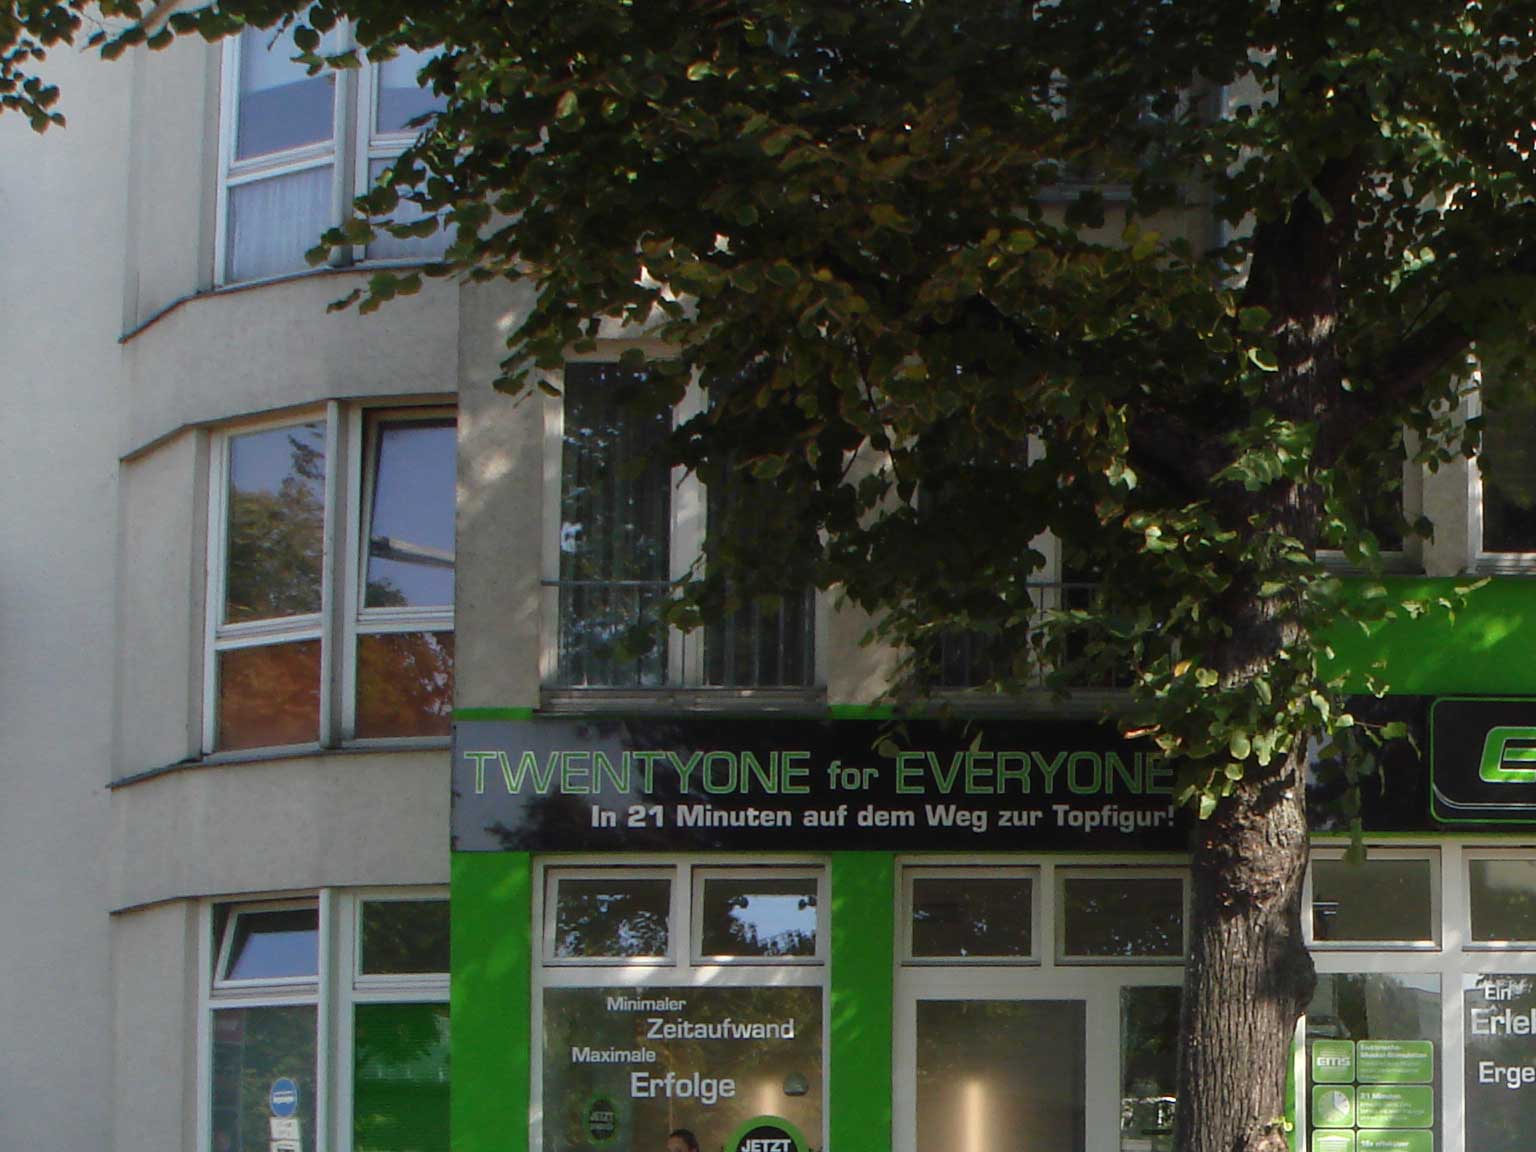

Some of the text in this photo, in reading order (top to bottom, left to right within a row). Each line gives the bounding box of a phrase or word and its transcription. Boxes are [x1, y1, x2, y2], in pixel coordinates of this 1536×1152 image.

[464, 751, 1174, 794] TWENTYONE for EVERYONE
[591, 805, 1175, 832] In 21 Minuten auf dem Weg zur Topfigur!
[1485, 984, 1512, 1000] Ein
[606, 997, 687, 1011] Minimaler
[646, 1018, 795, 1039] Zeitaufwand
[571, 1047, 657, 1063] Maximale
[630, 1072, 736, 1104] Erfolge
[741, 1139, 791, 1152] JETZT
